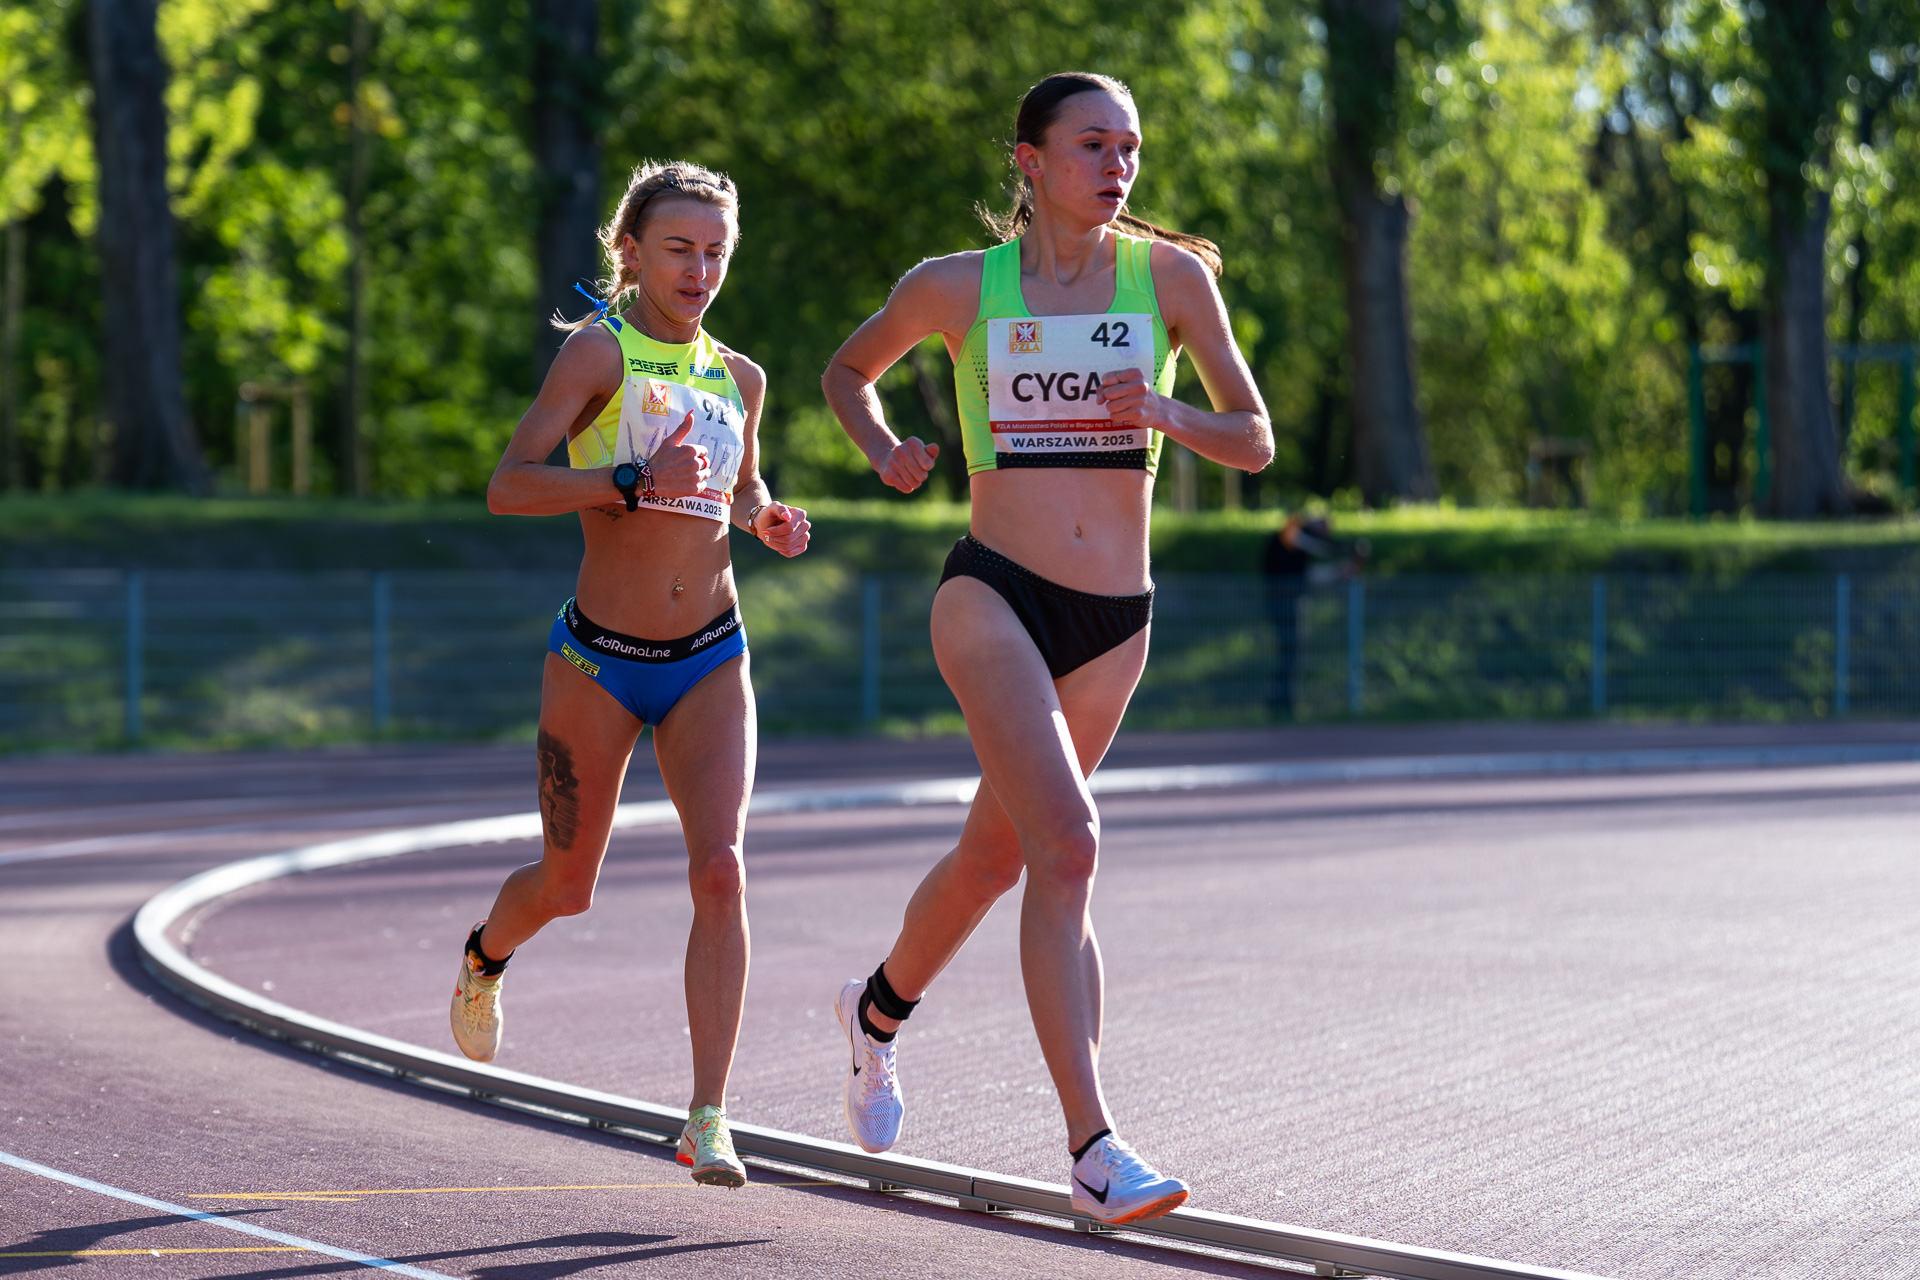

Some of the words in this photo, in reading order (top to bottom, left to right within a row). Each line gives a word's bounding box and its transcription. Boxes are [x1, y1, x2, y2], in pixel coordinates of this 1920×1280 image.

[1090, 321, 1130, 348] 42
[1010, 342, 1041, 353] PZLA
[1011, 372, 1102, 402] CYGA
[643, 404, 669, 415] PZLA
[703, 398, 728, 426] 91
[1050, 422, 1069, 430] Polski
[1011, 436, 1098, 448] WARSZAWA
[1101, 434, 1134, 446] 2025
[642, 496, 702, 513] ARSZAWA
[704, 503, 723, 517] 2025
[592, 635, 671, 658] AdRunaLine
